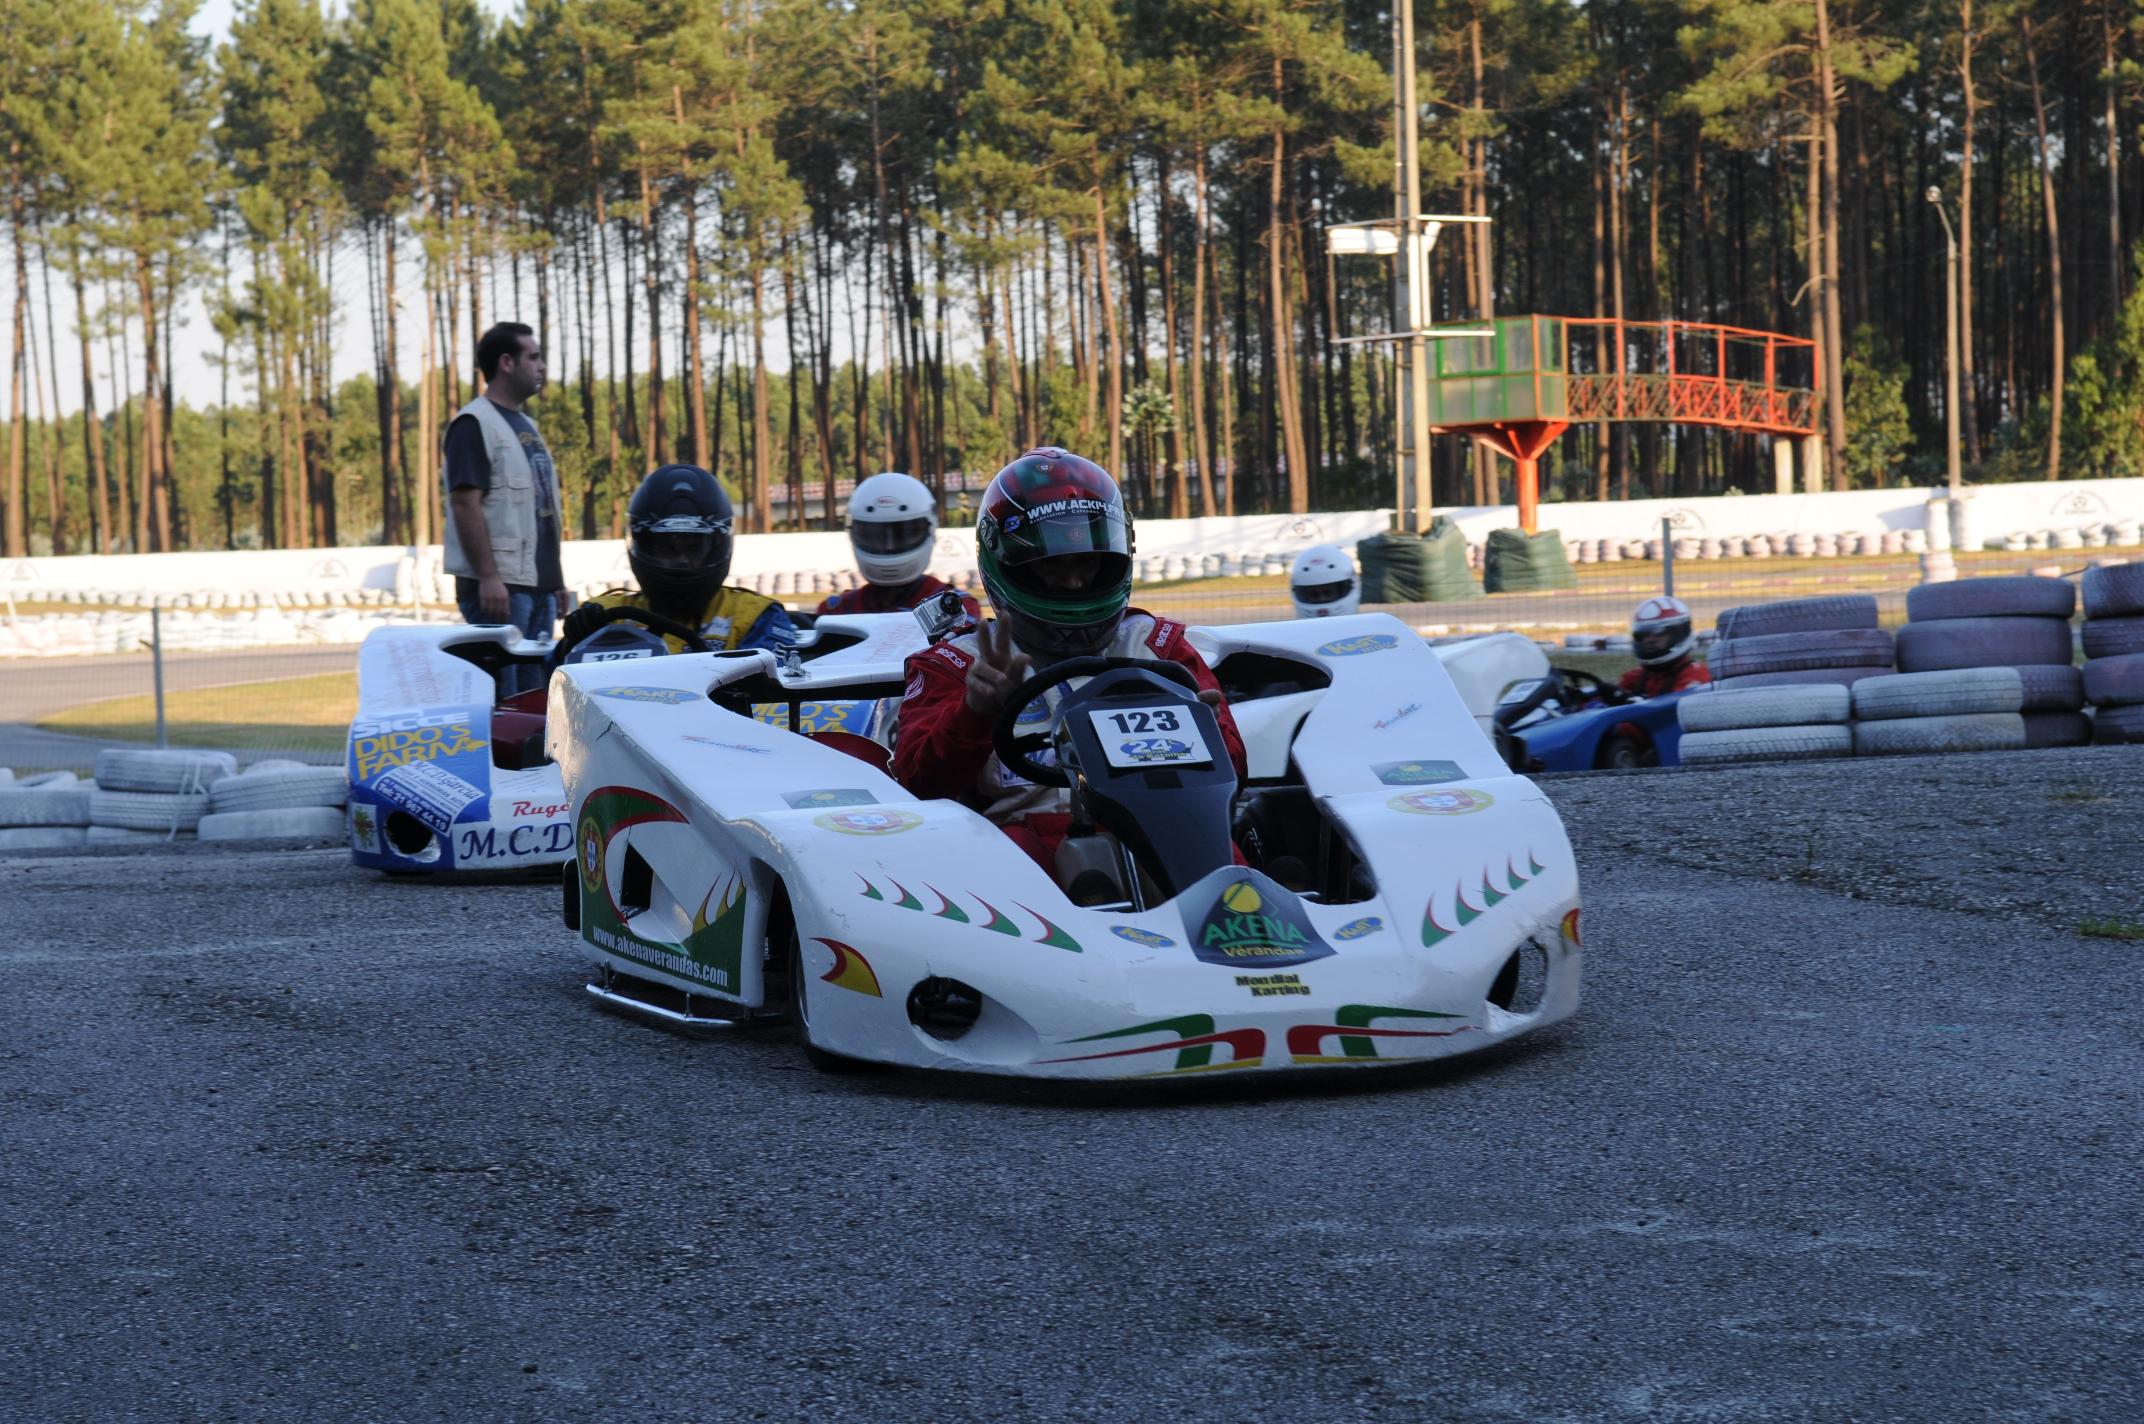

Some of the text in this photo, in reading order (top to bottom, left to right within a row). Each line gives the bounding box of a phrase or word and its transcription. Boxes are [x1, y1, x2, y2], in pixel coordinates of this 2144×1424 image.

[353, 712, 471, 739] SICCE
[1108, 710, 1180, 733] 123
[354, 722, 472, 760] DIDO'S
[1131, 739, 1172, 753] 24
[357, 737, 472, 780] FARM
[1203, 913, 1311, 946] AKENA
[593, 925, 728, 987] www.akenaverandas.com
[1236, 974, 1300, 986] Mondial
[1251, 984, 1311, 997] Karting
